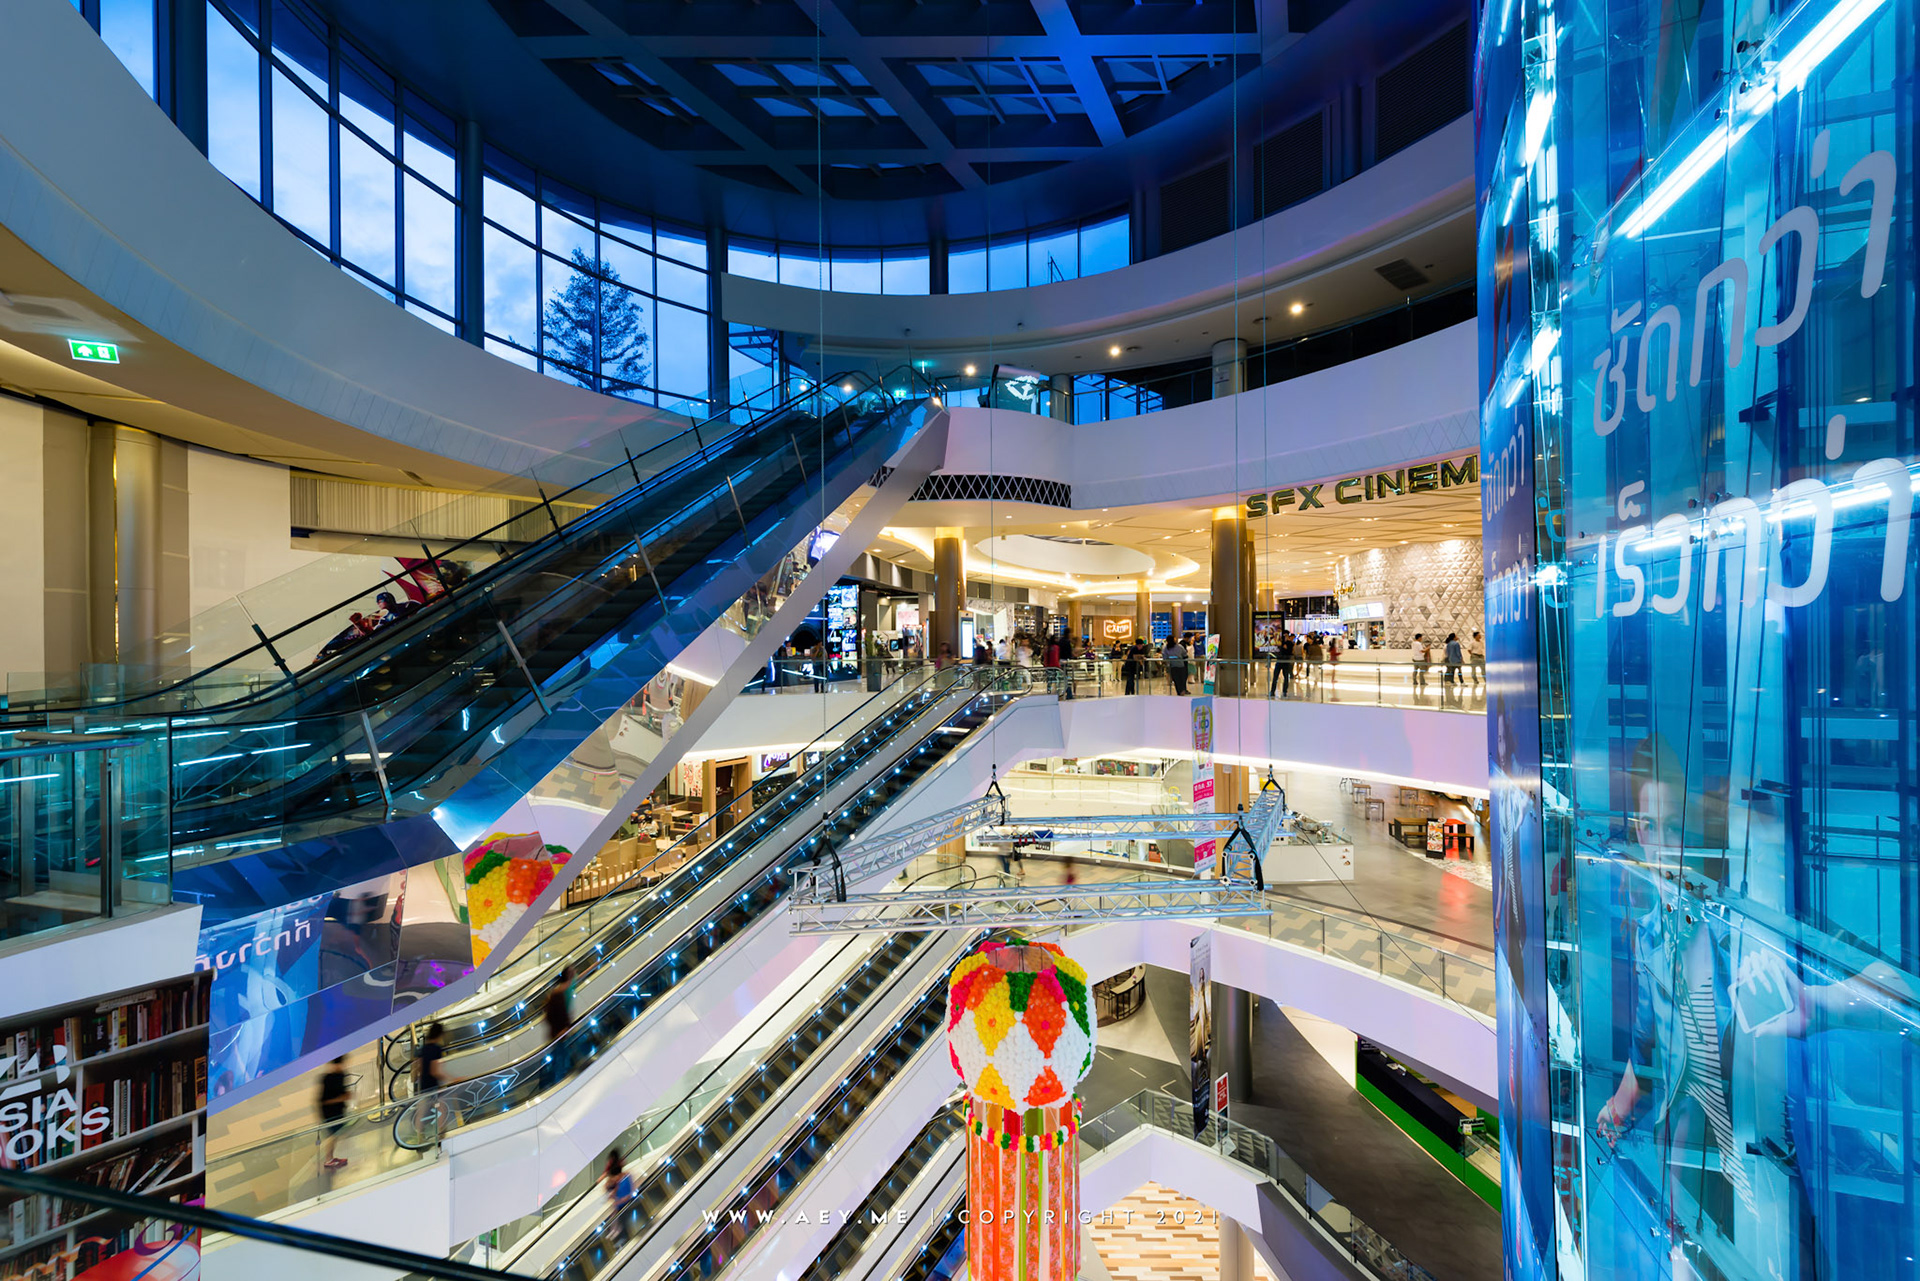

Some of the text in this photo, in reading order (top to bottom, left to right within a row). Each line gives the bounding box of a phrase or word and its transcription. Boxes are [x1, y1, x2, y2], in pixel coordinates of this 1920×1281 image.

[1593, 129, 1897, 437] ชัดกว่า
[1246, 455, 1478, 518] SFX CINEM
[1486, 405, 1525, 522] ชัดกว่า
[1596, 414, 1912, 618] เร็วกว่า
[1488, 533, 1529, 626] เร็วกว่า
[0, 1106, 111, 1160] OKS
